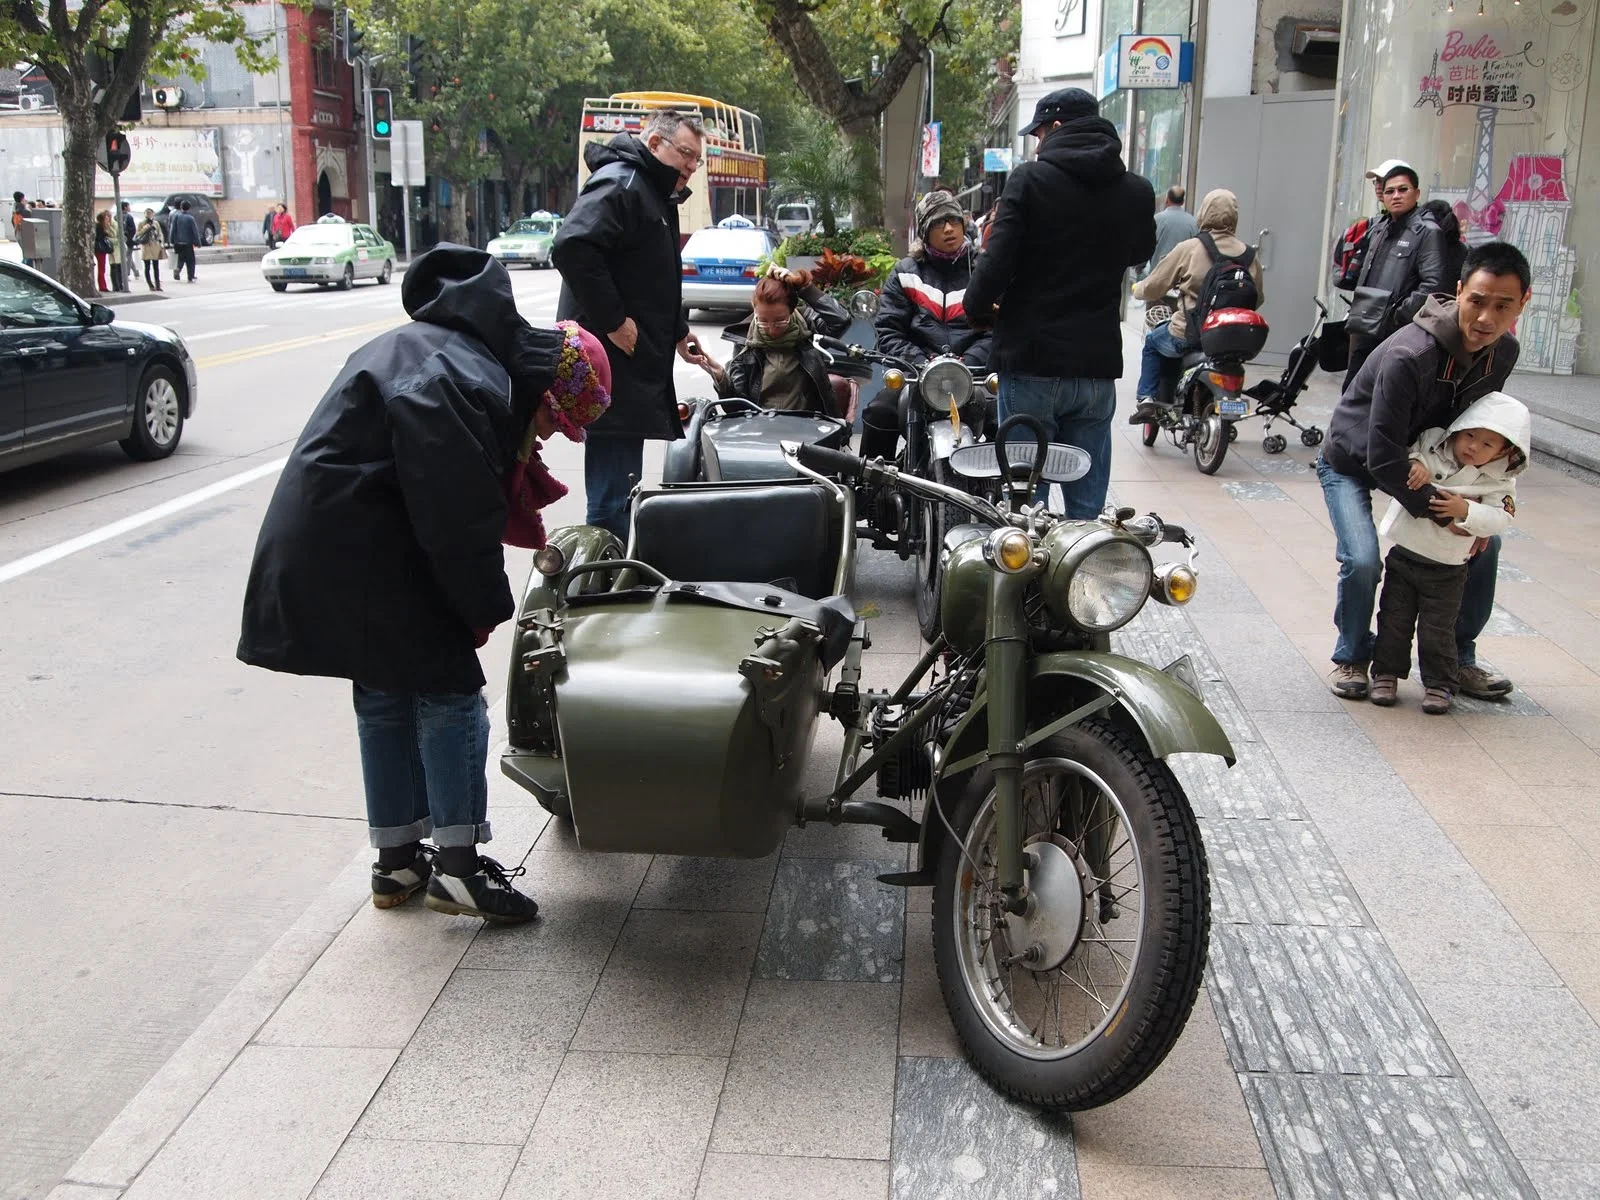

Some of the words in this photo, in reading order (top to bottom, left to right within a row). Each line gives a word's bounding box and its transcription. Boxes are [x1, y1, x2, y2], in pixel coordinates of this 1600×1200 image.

[1441, 31, 1501, 62] Barbie
[1448, 65, 1479, 81] 芭比
[1483, 60, 1489, 71] A
